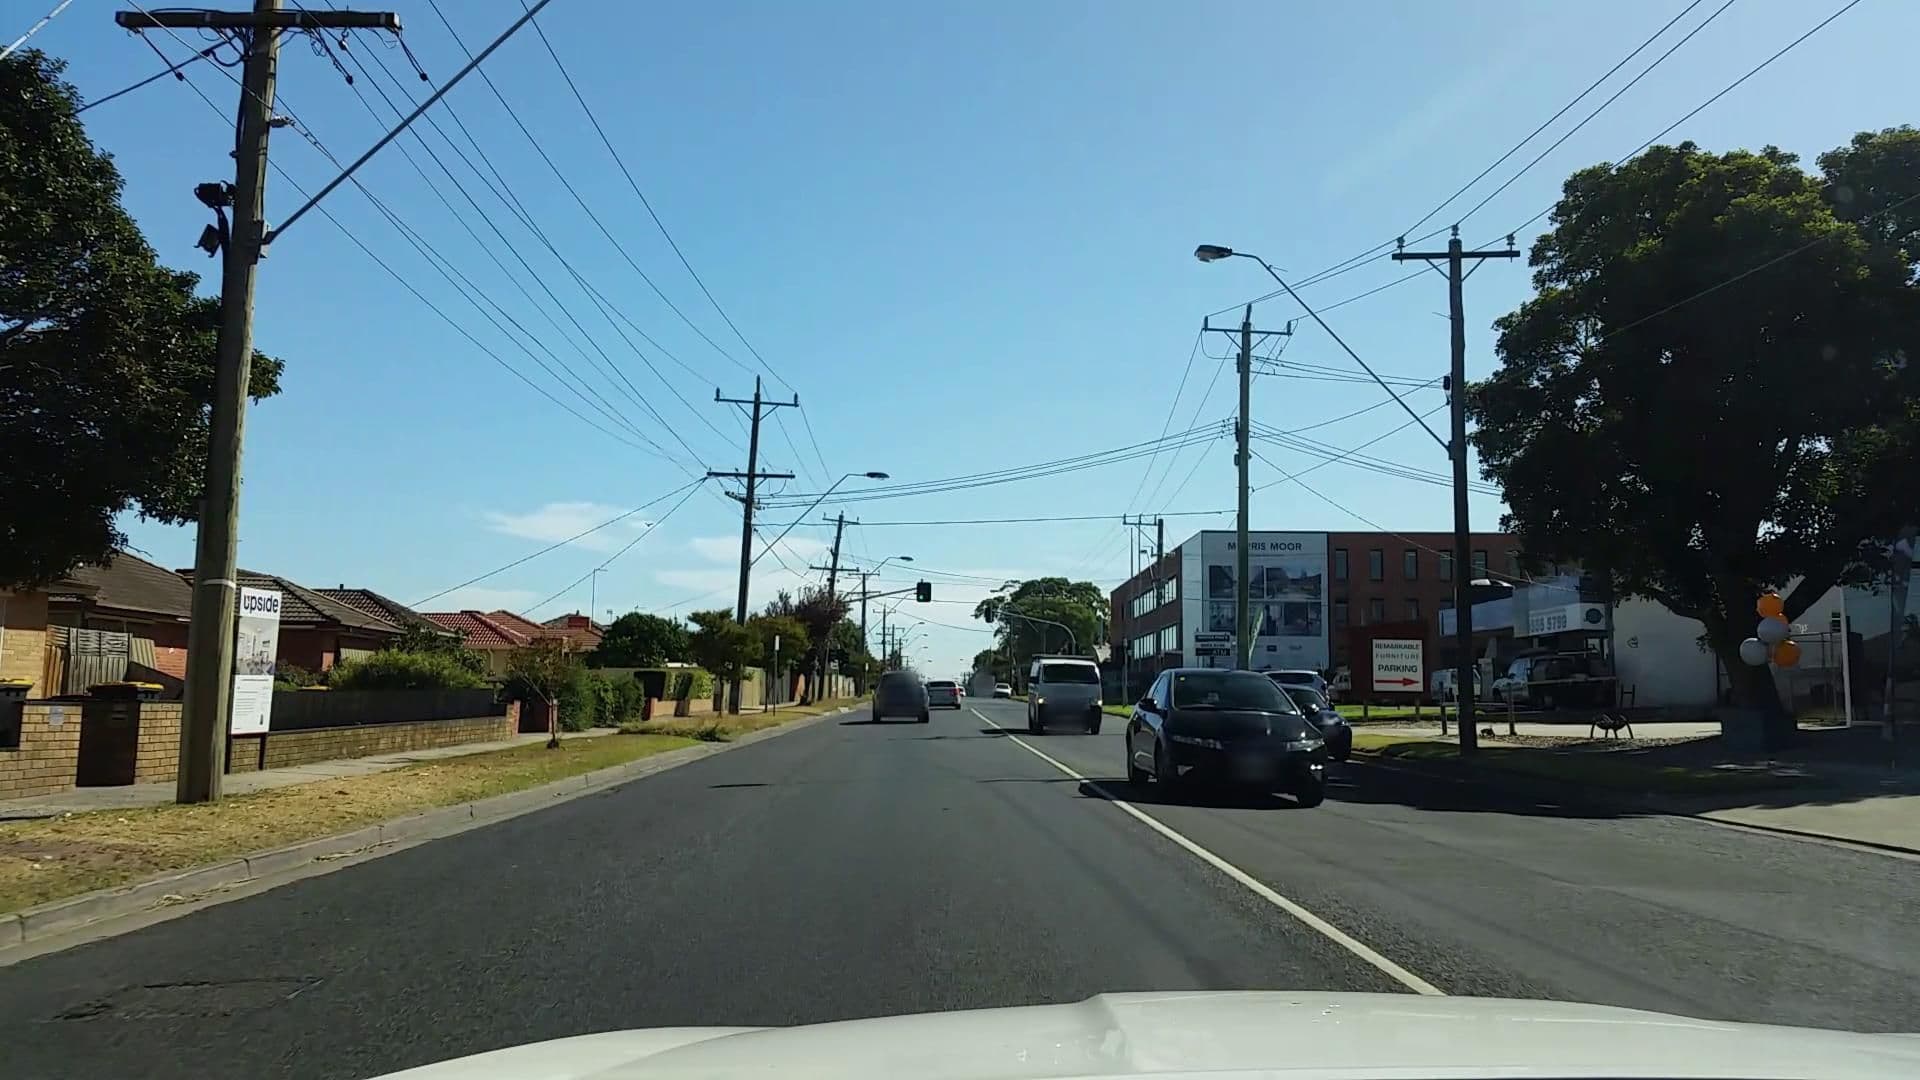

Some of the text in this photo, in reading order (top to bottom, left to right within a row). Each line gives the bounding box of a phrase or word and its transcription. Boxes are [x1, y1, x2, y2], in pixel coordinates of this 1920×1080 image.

[1227, 542, 1302, 551] MRIS MOOR
[243, 594, 279, 614] upside
[1377, 664, 1418, 673] PARKING
